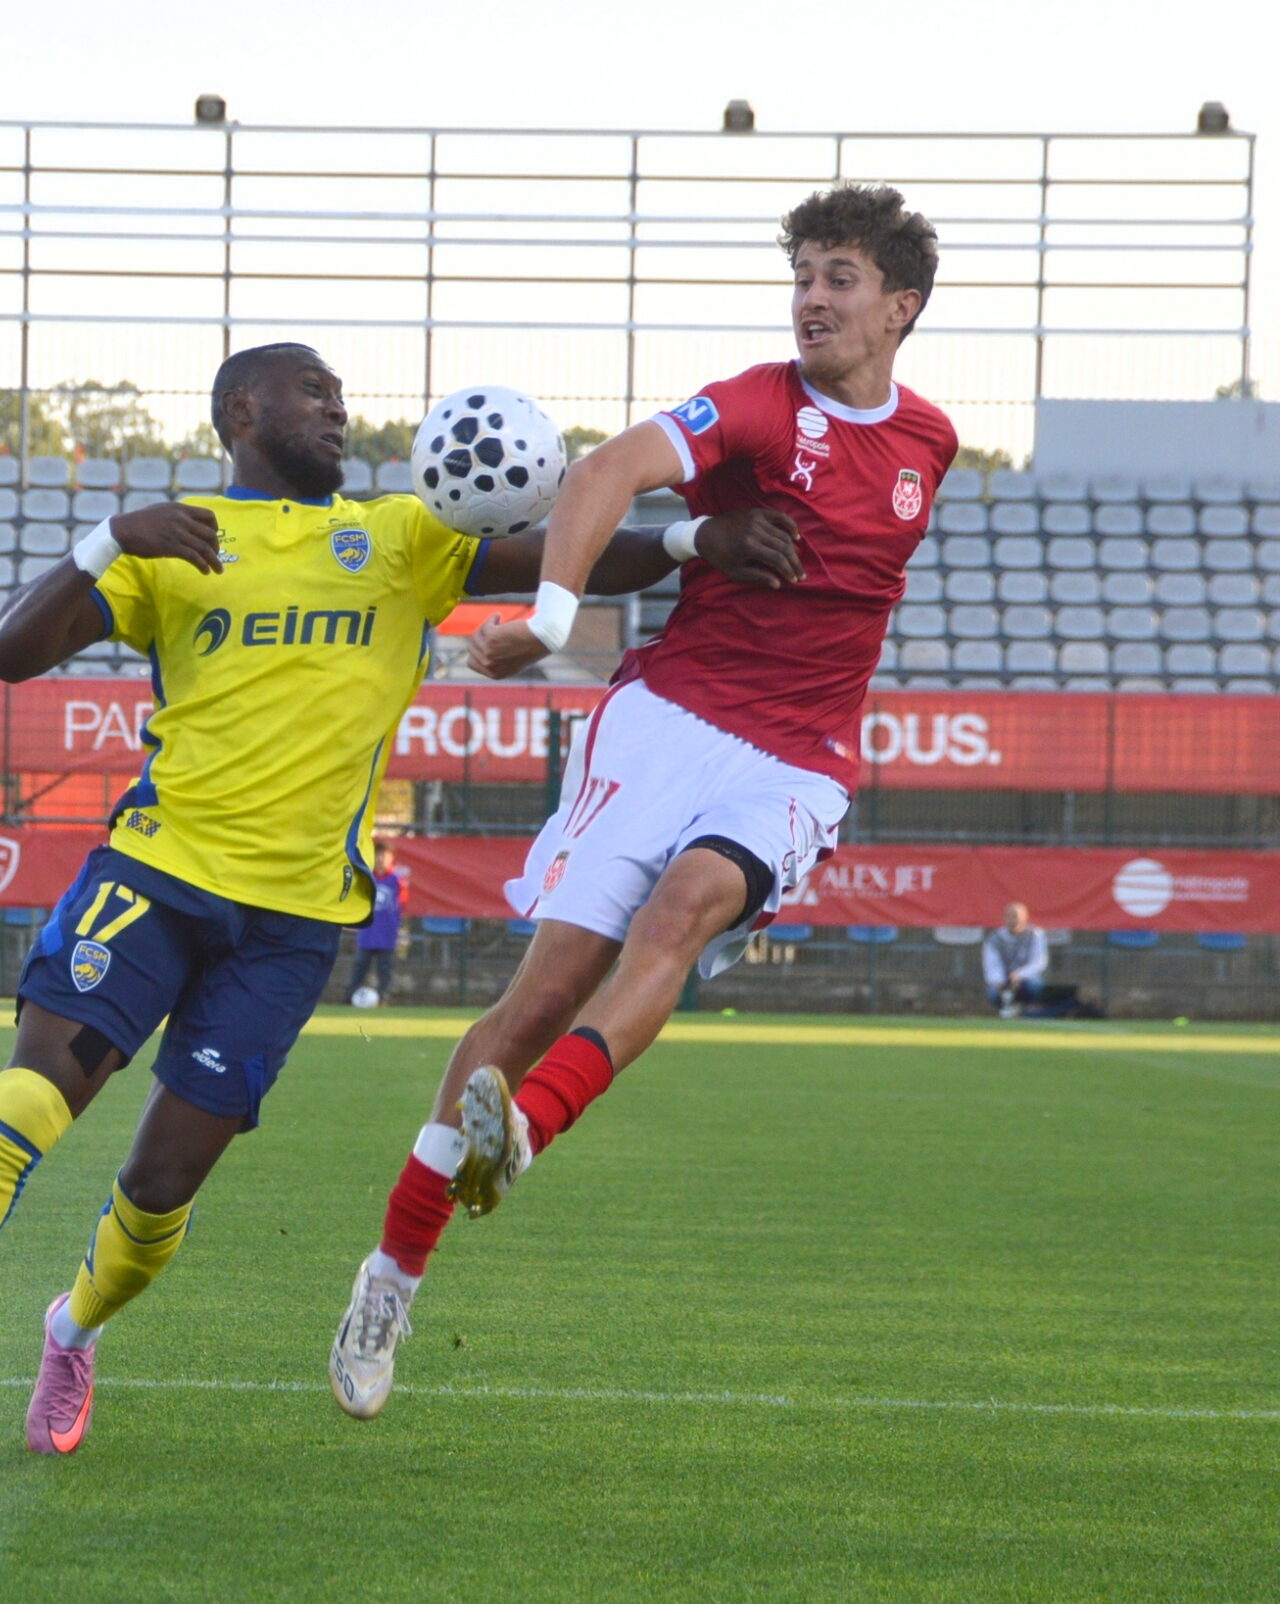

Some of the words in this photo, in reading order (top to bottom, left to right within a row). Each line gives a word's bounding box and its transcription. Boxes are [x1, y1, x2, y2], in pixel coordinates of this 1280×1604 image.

[335, 533, 365, 544] FCSM
[820, 864, 890, 890] ALEX
[893, 864, 938, 897] JET
[75, 881, 151, 944] 17
[78, 944, 109, 963] FCSM
